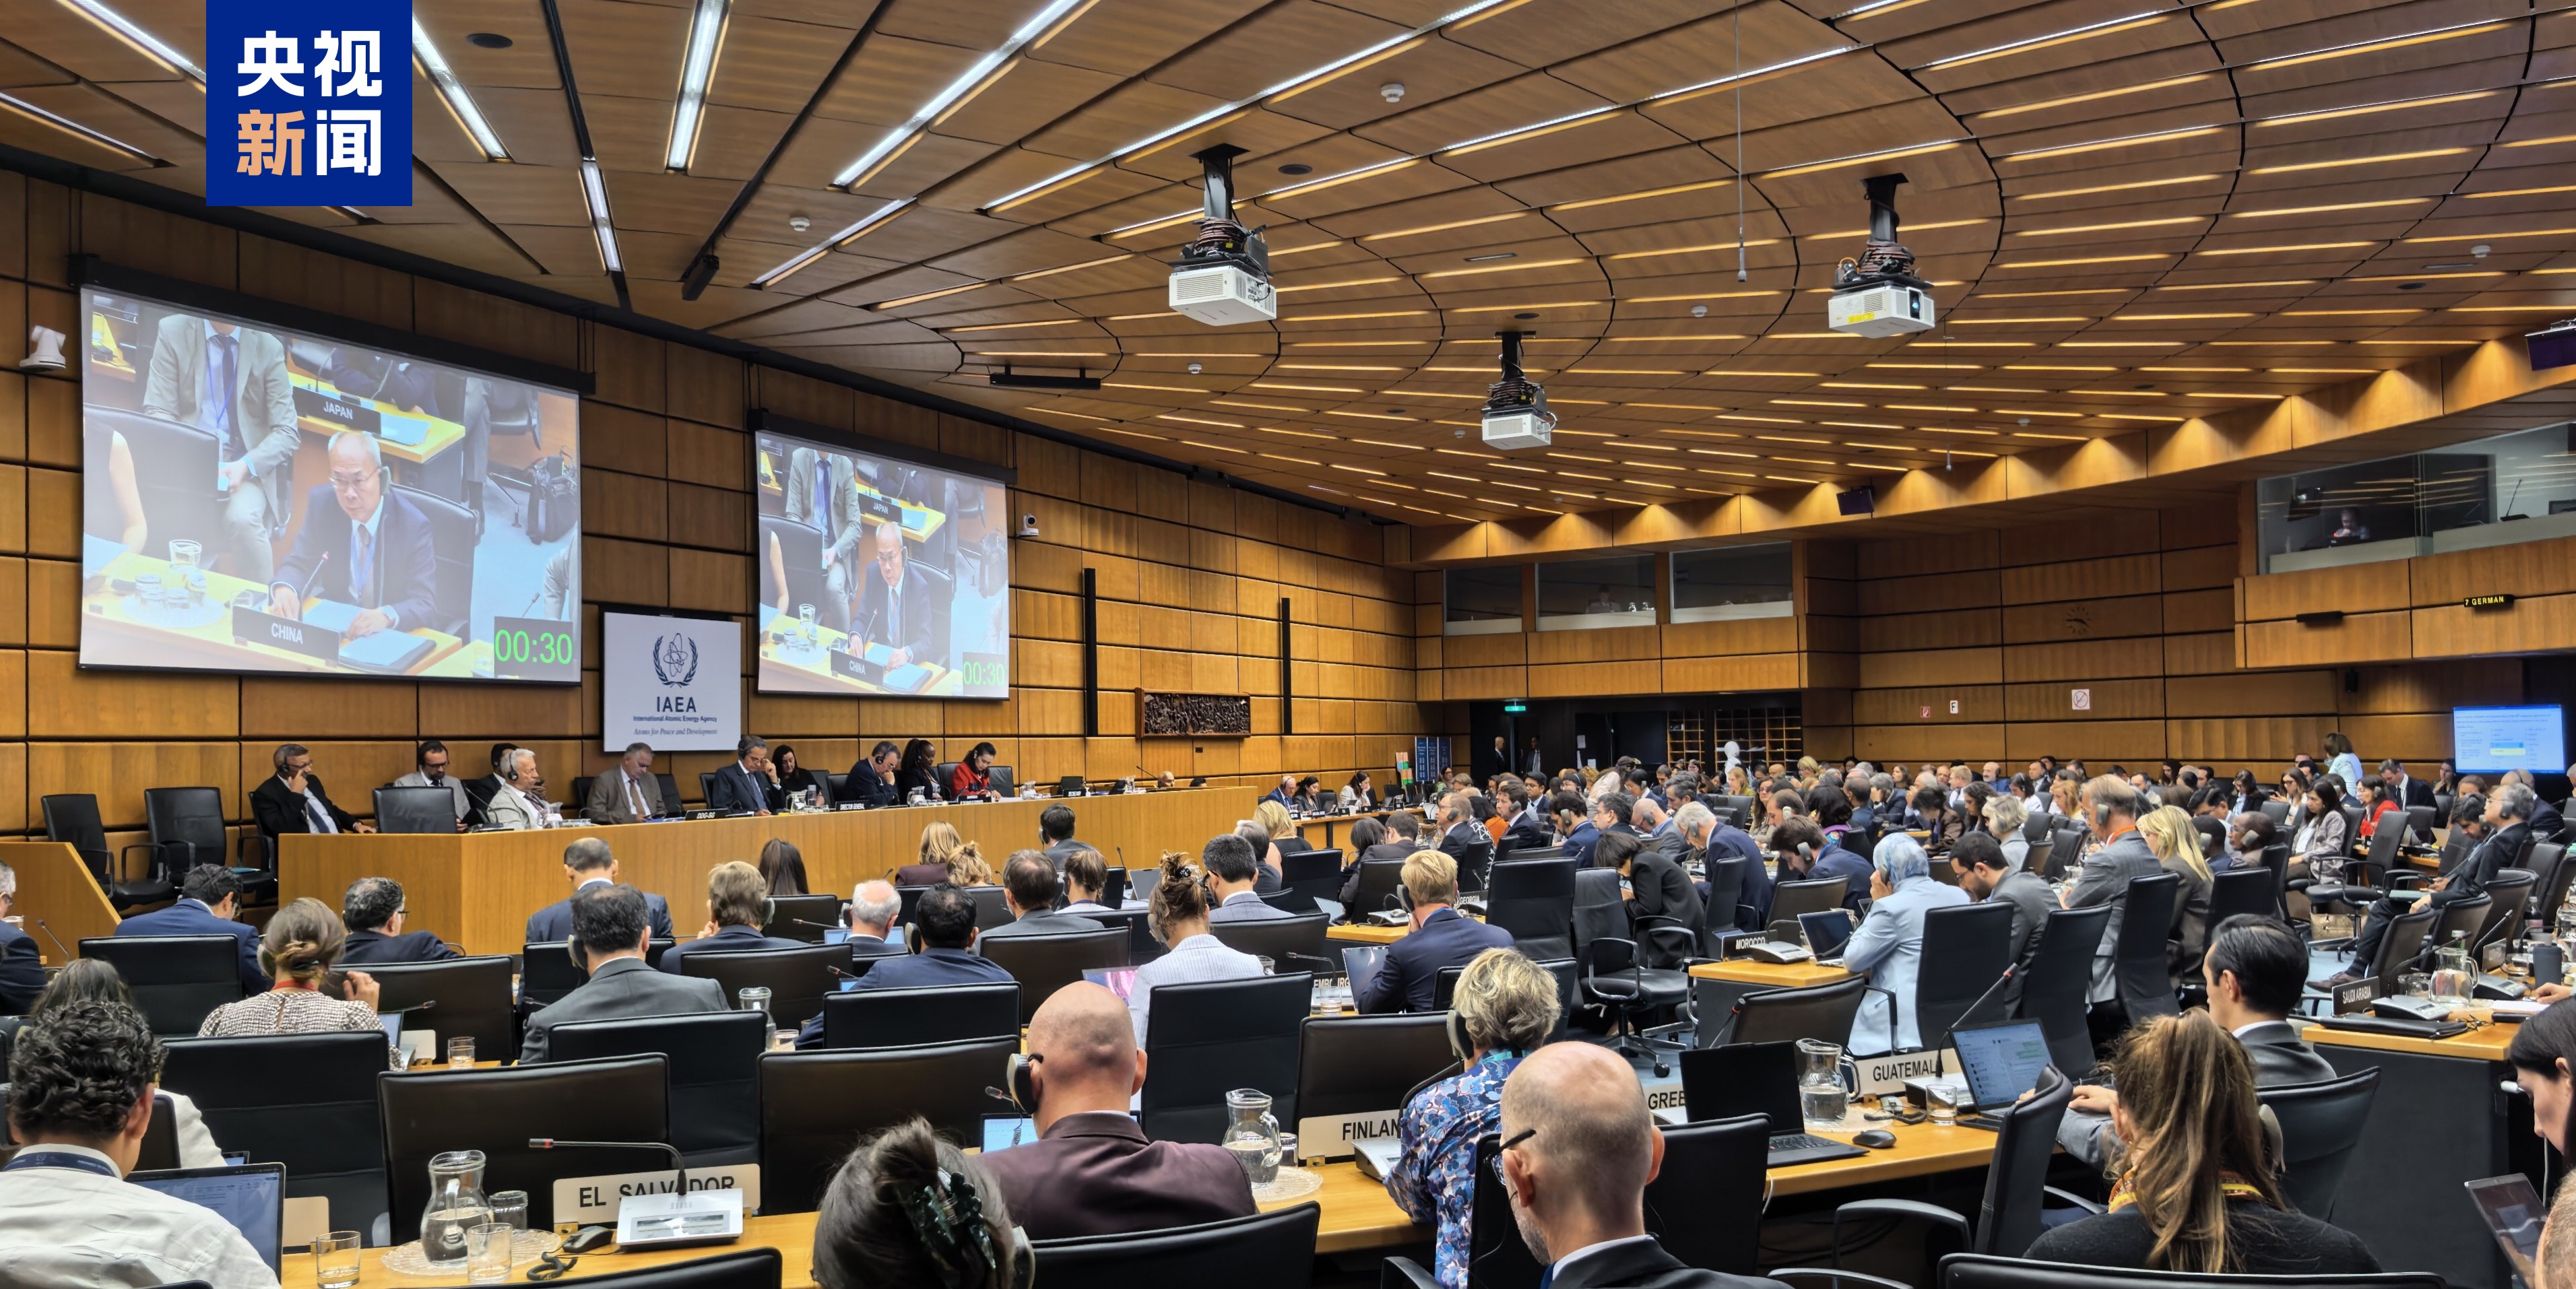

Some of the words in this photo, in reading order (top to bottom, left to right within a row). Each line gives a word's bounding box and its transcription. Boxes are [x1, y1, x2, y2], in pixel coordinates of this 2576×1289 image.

[323, 401, 353, 420] JAPAN
[873, 502, 889, 515] JAPAN
[2472, 595, 2504, 605] GERMAN
[271, 622, 303, 644] CHINA
[495, 630, 573, 665] 00:30
[849, 660, 866, 675] CHINA
[963, 661, 1005, 686] 00:30
[657, 696, 697, 713] IAEA
[1951, 702, 1956, 712] F
[1460, 895, 1480, 904] GEORGIA
[1735, 936, 1766, 950] MOROCCO
[2356, 985, 2371, 1001] ARABIA
[1873, 1059, 1944, 1081] GUATEMAL
[579, 1187, 606, 1208] EL
[619, 1176, 735, 1201] SALVDOR
